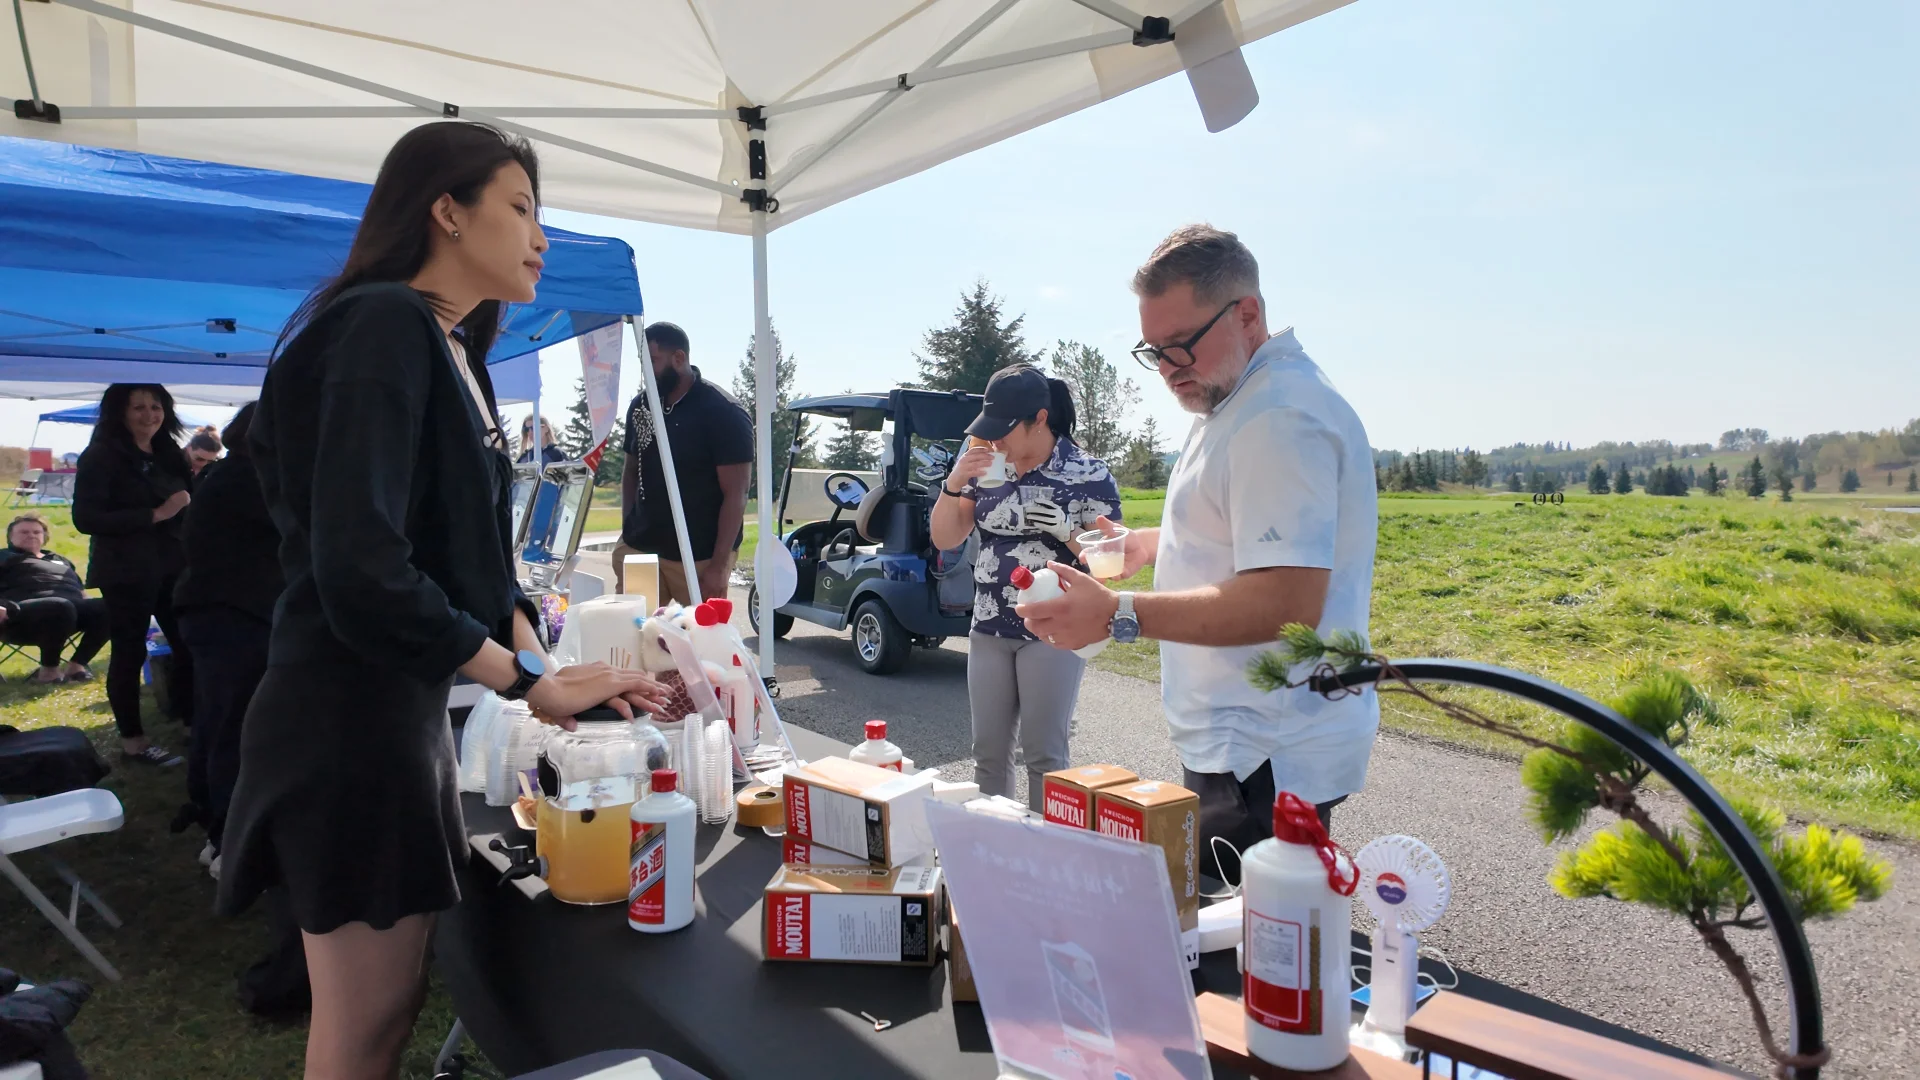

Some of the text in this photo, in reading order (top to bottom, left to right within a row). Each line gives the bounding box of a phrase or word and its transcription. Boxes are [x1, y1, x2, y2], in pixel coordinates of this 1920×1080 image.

[794, 784, 809, 836] MOUTAI
[1046, 797, 1085, 827] MOUTAI
[785, 896, 803, 954] MOUTAI
